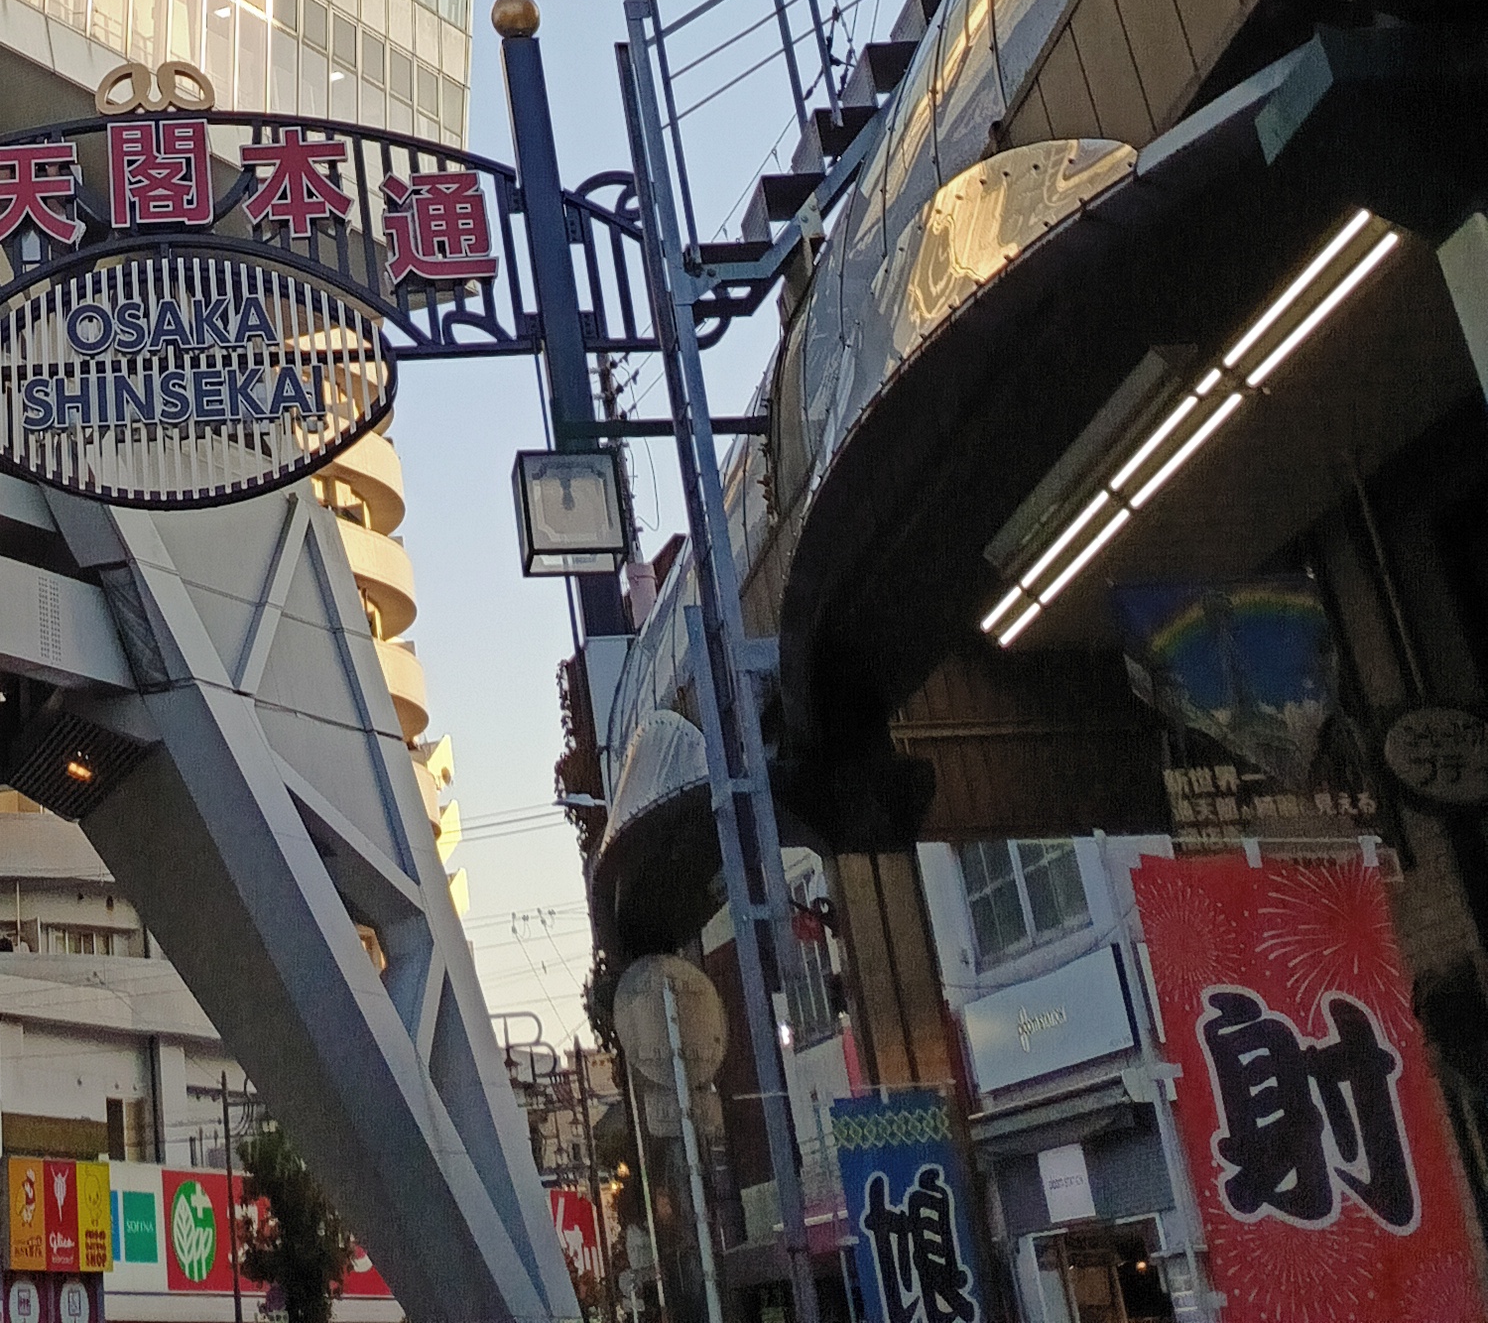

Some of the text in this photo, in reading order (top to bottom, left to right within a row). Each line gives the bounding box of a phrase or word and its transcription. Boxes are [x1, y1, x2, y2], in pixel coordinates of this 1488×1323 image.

[65, 293, 279, 356] OSAKA
[22, 363, 326, 432] SHINSEKAI
[1199, 988, 1418, 1232] 射
